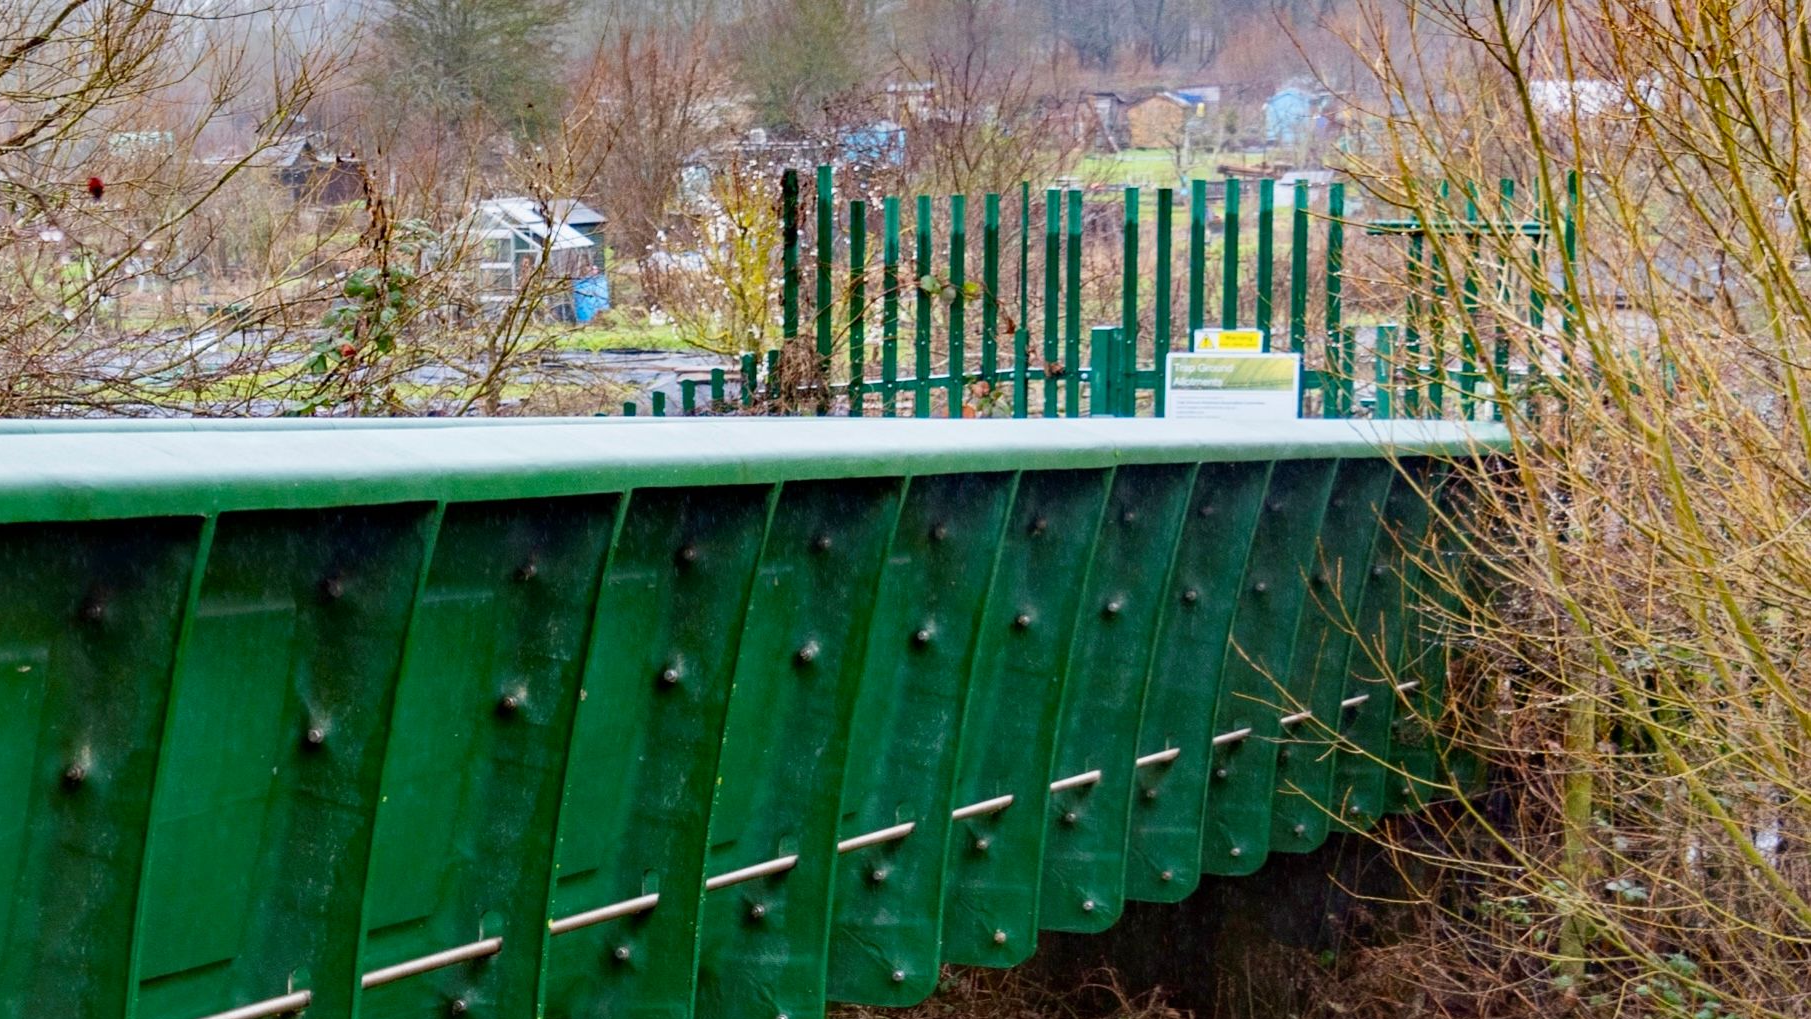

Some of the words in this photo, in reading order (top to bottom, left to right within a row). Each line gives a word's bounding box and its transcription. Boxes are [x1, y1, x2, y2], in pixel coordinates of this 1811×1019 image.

[1173, 363, 1195, 374] Trap
[1198, 363, 1234, 373] Ground
[1173, 378, 1223, 387] Allotments
